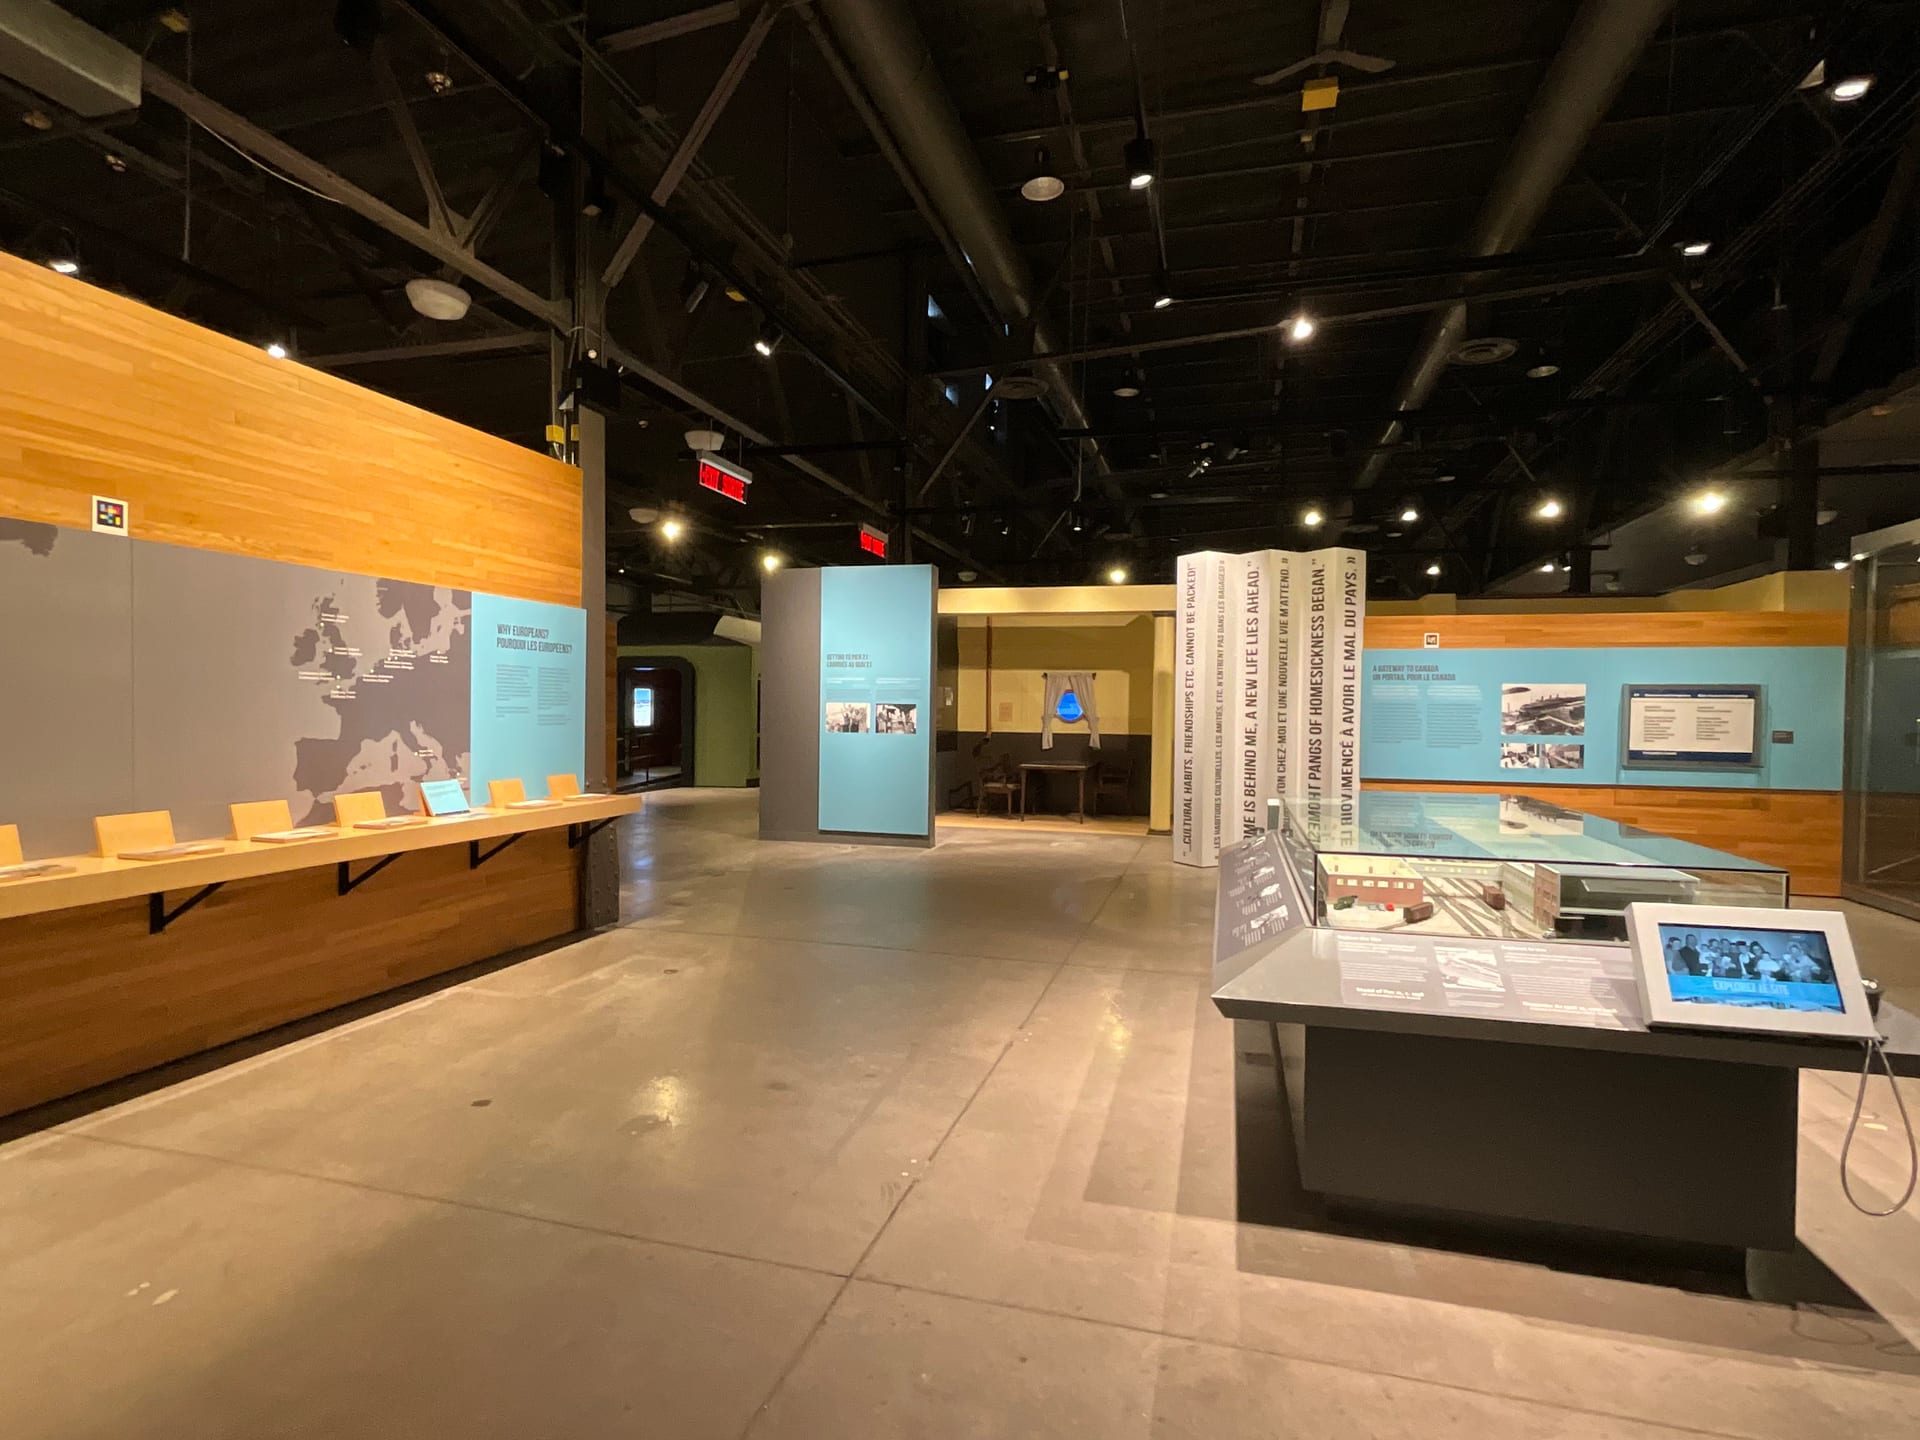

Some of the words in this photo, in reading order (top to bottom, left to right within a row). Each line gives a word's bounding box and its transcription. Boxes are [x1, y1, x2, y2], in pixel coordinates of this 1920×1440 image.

[1187, 611, 1195, 623] BE
[1279, 619, 1289, 634] VIE
[1344, 609, 1356, 628] DU
[496, 624, 511, 634] WHY
[512, 625, 549, 640] EUROPEANS?
[1246, 617, 1258, 644] LIES
[496, 637, 526, 650] POURQUOI
[527, 640, 537, 651] LES
[1186, 627, 1195, 664] CANNOT
[1343, 632, 1356, 661] MAL
[1246, 648, 1258, 675] LIFE
[1278, 638, 1289, 687] NOUVELLE
[1309, 615, 1324, 715] HOMESICKNESS
[1406, 665, 1414, 673] TO
[1415, 665, 1439, 673] CANADA
[1343, 664, 1355, 680] LE
[1245, 679, 1257, 707] NEW
[1278, 689, 1288, 709] UNE
[1342, 684, 1355, 724] AVOIR
[1184, 691, 1194, 753] FRIENDSHIPS
[1245, 711, 1257, 720] A
[1278, 712, 1287, 723] ET
[1309, 719, 1322, 735] OF
[1339, 728, 1354, 737] À
[1277, 726, 1287, 773] CHEZ-MOI
[1308, 738, 1322, 780] PANGS
[1244, 750, 1256, 797] BEHIND
[1244, 800, 1256, 812] IS
